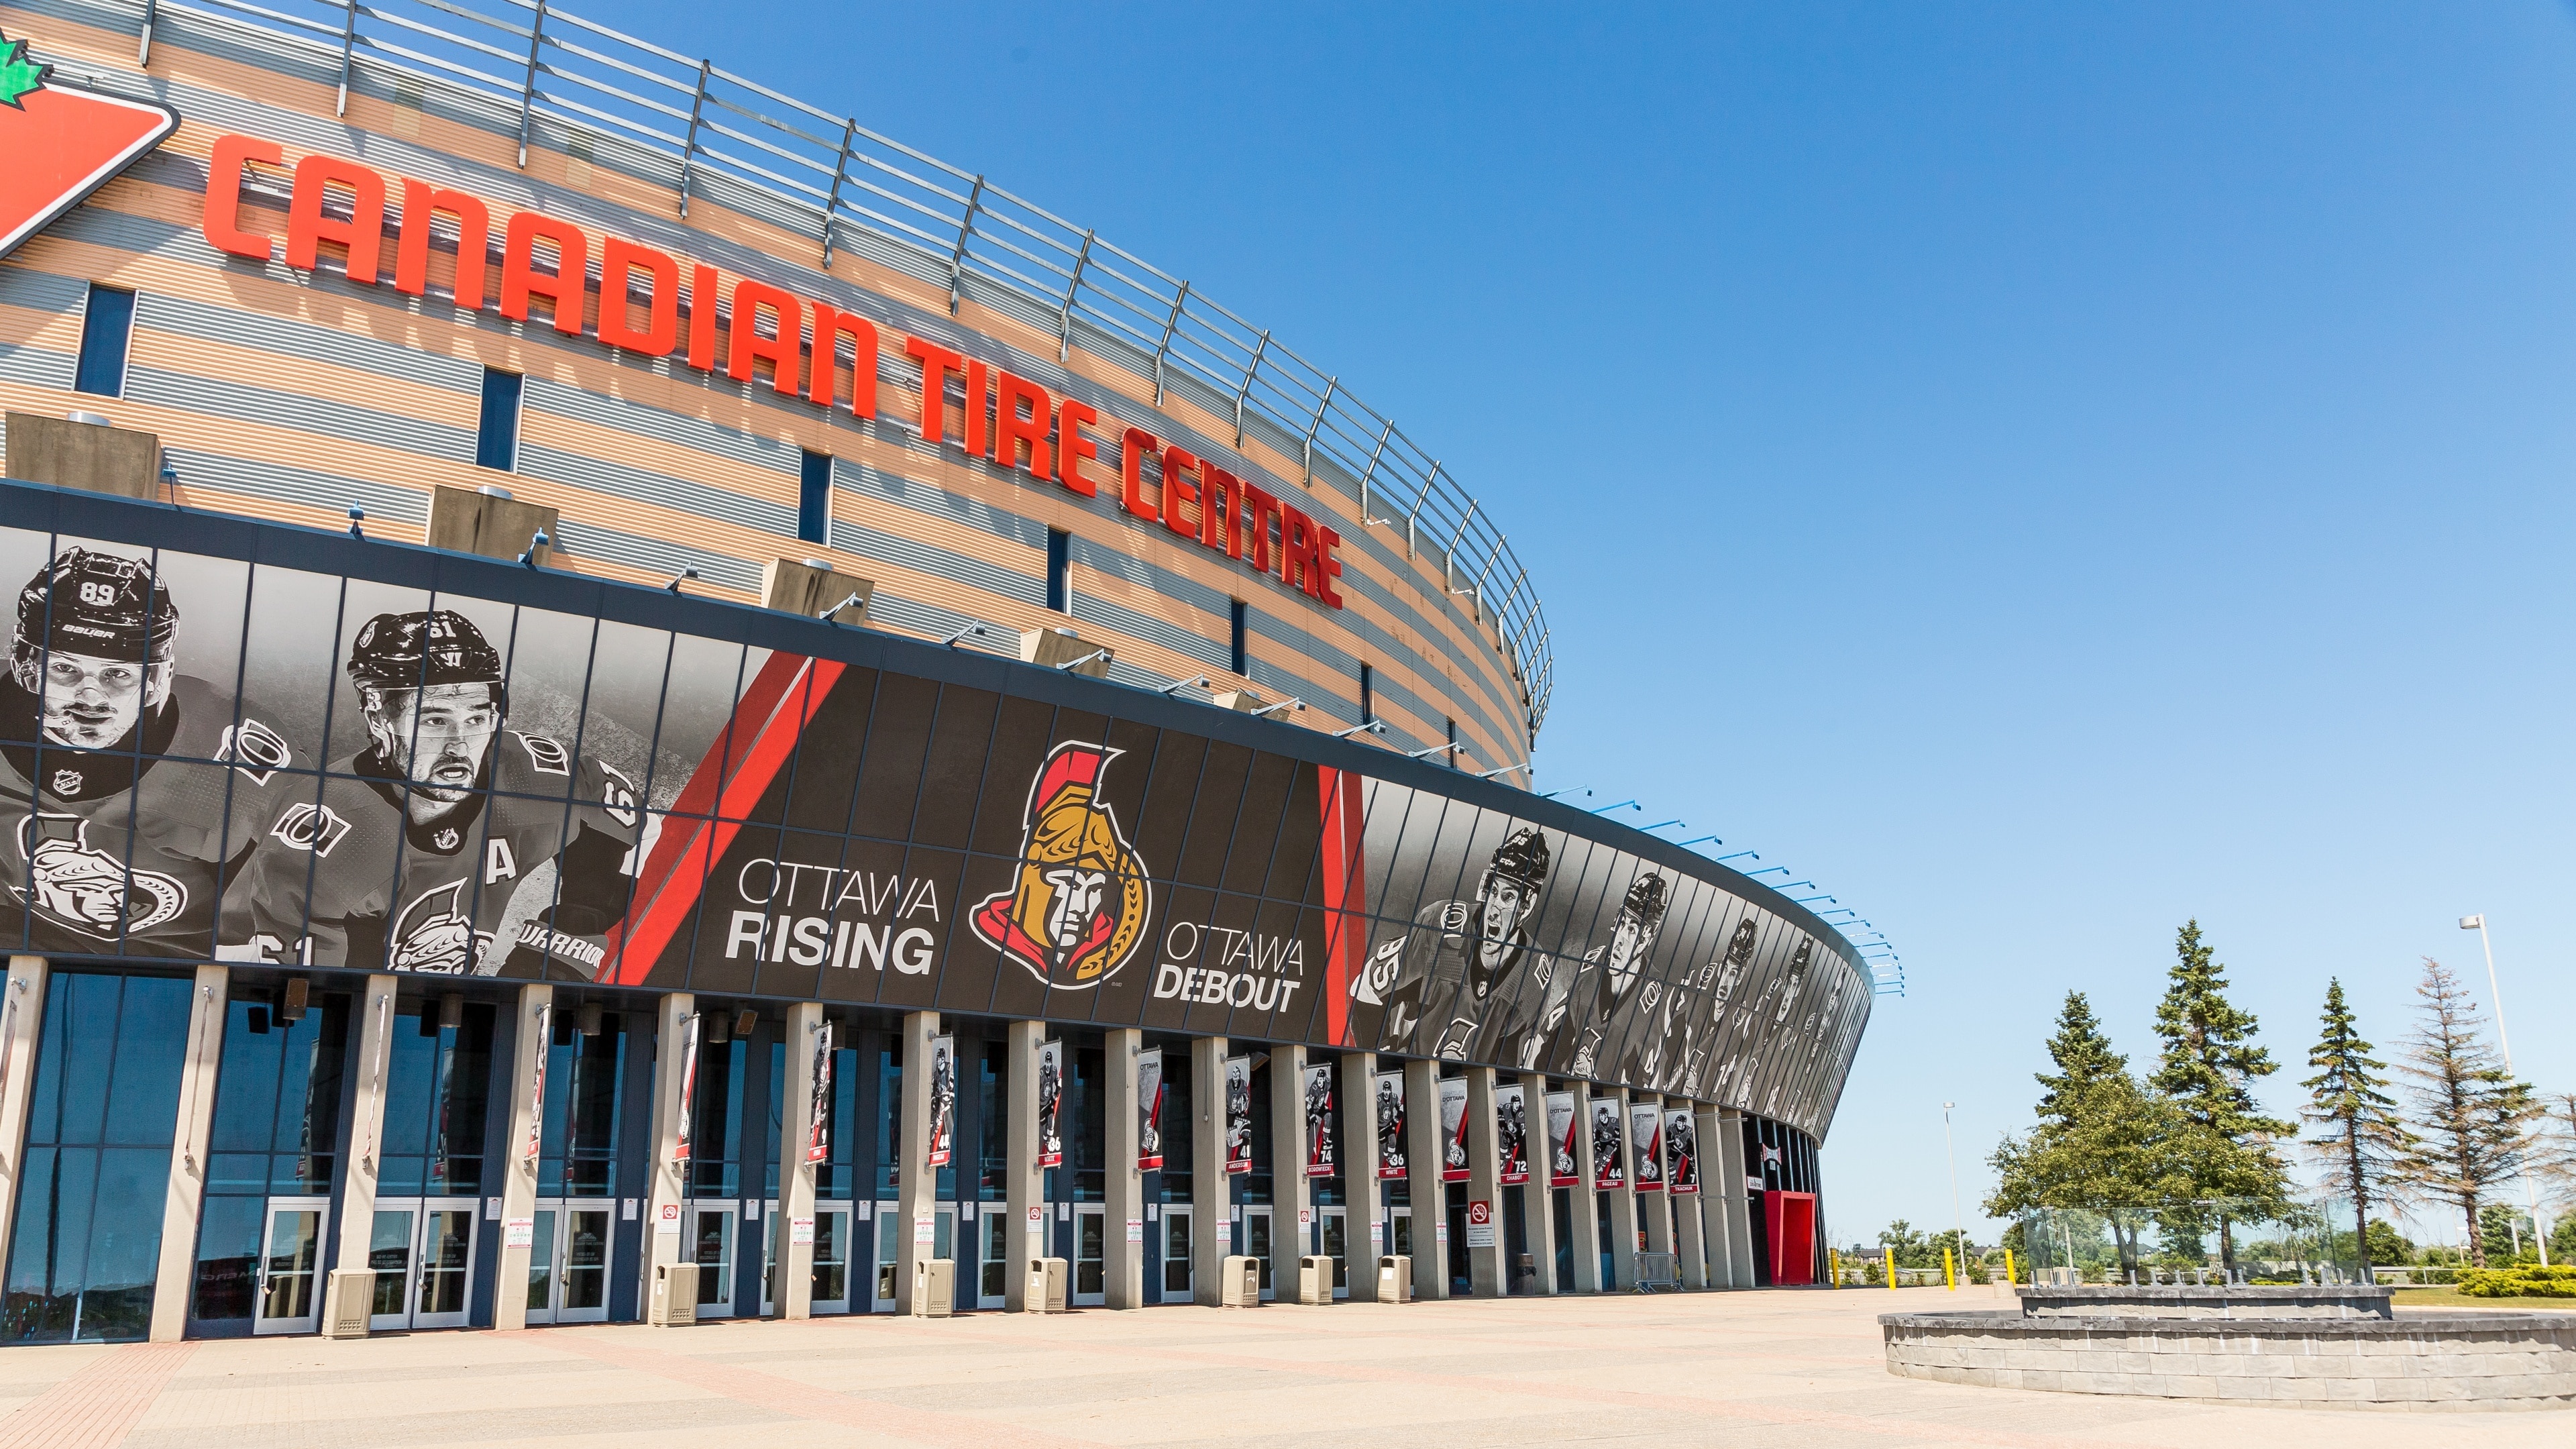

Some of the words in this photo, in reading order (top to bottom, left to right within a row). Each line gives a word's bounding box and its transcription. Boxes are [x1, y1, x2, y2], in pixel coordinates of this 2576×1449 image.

[203, 134, 879, 421] CANADIAN
[904, 335, 1097, 498] TIRE
[1121, 427, 1343, 610] CENTRE
[80, 582, 115, 606] 89
[486, 838, 517, 884] A
[739, 858, 939, 922] OTTAWA
[519, 924, 606, 969] WARRIOR
[725, 910, 934, 975] RISING
[1153, 963, 1301, 1012] DEBOUT
[1140, 1062, 1159, 1070] OTTAWA
[1240, 1144, 1250, 1159] 41
[1321, 1150, 1332, 1163] 74
[1391, 1153, 1404, 1166] 36
[1515, 1161, 1527, 1172] 72
[1609, 1168, 1622, 1179] 44
[1690, 1174, 1696, 1183] 7
